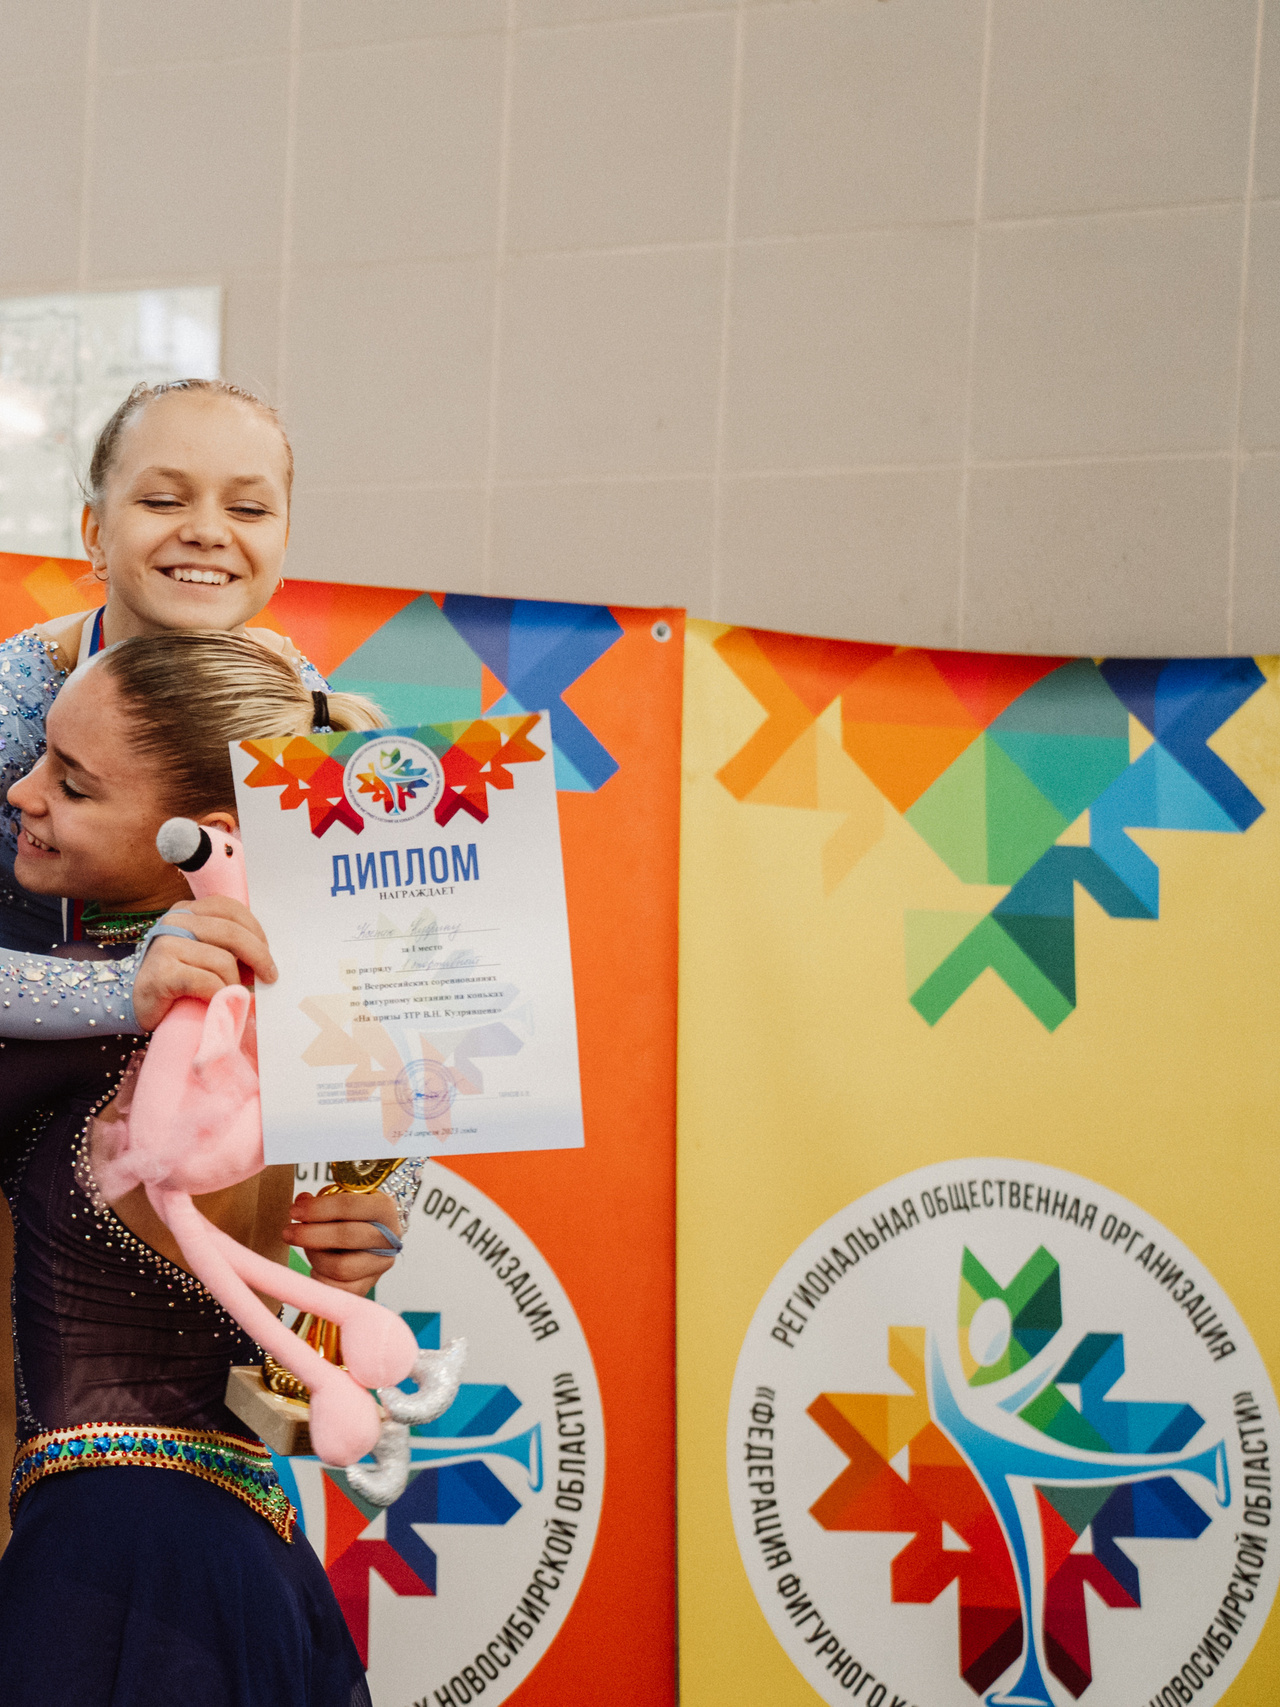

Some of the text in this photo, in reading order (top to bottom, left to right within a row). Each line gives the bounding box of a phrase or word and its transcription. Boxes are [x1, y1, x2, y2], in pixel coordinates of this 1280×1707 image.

[331, 843, 480, 897] ДИПЛОМ
[379, 886, 456, 900] НАГРАЖДАЕТ
[345, 965, 392, 978] по разряду
[364, 980, 429, 992] Всероссийских
[431, 974, 497, 986] соревнованиях
[362, 997, 411, 1009] фигурному
[413, 994, 451, 1003] катанию
[467, 990, 504, 999] коньках
[373, 1013, 401, 1023] призы
[414, 1129, 440, 1138] апреля
[422, 1188, 560, 1341] ОРГАНИЗАЦИЯ
[770, 1179, 1236, 1362] РЕГИОНАЛЬНАЯ ОБЩЕСТВЕННАЯ ОРГАНИЗАЦИЯ
[744, 1386, 887, 1707] «ФЕДЕРАЦИЯ ФИГУРНОГО
[433, 1518, 580, 1707] НОВОСИБИРСКОЙ
